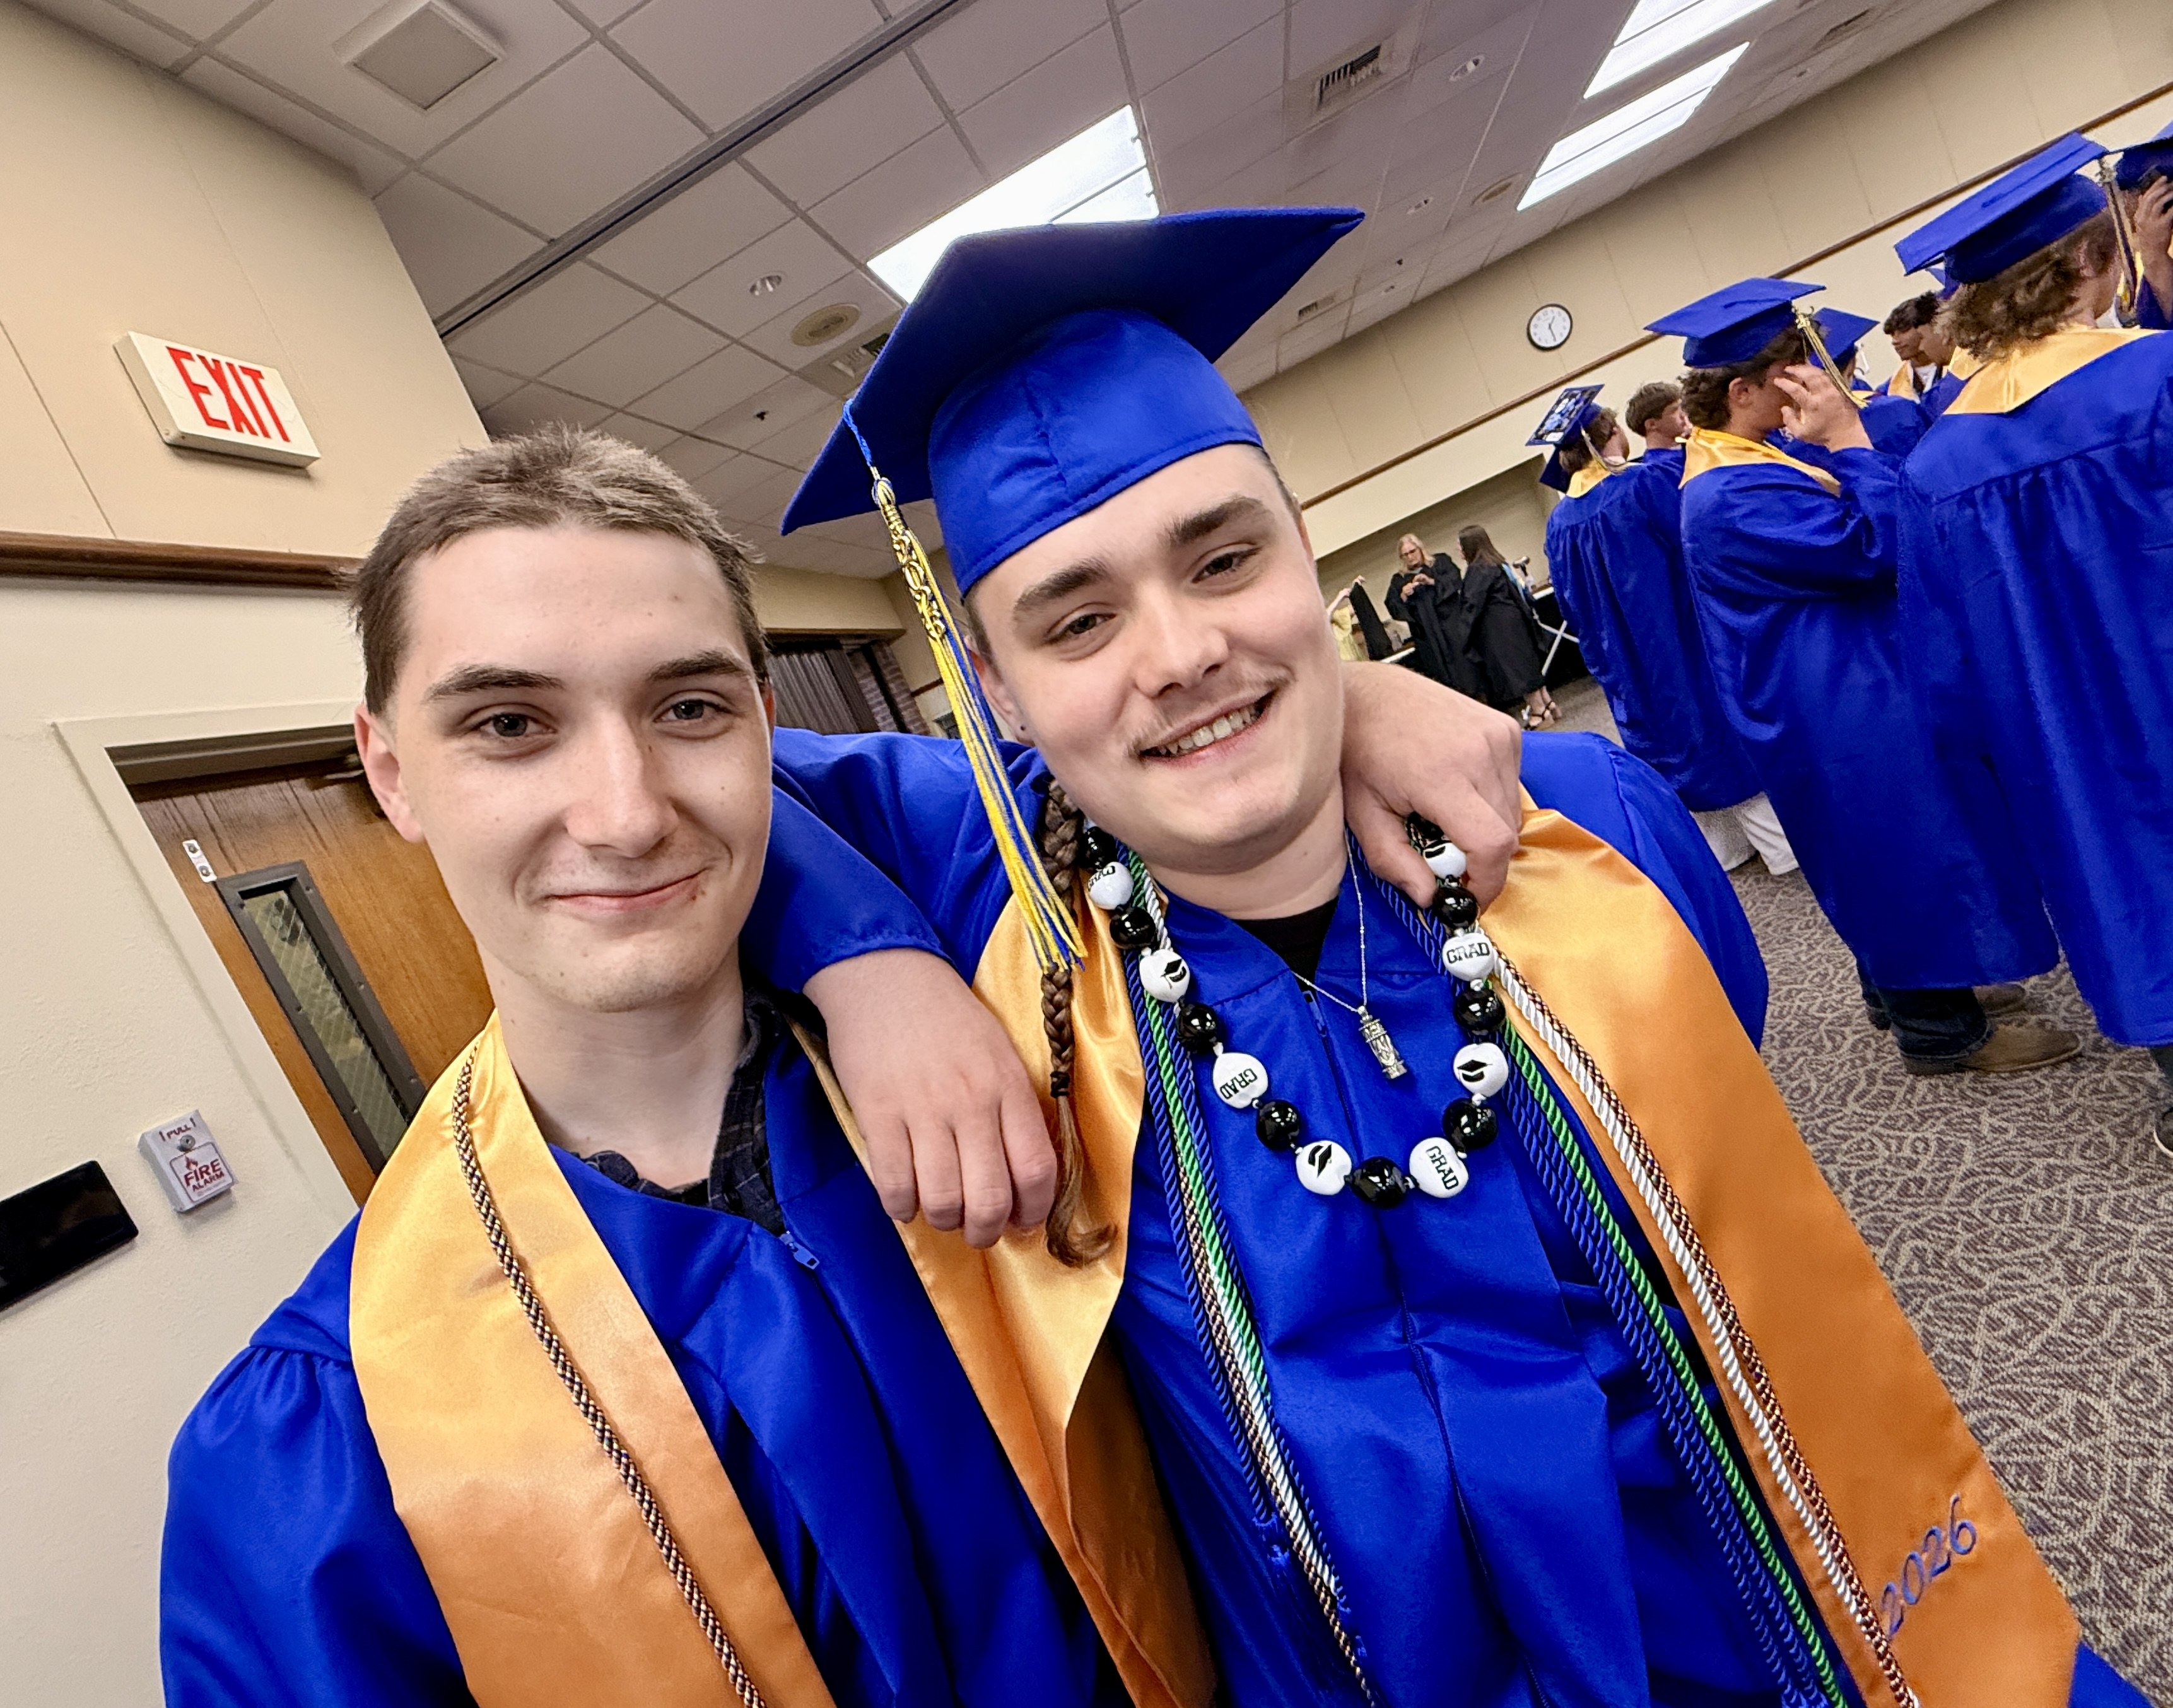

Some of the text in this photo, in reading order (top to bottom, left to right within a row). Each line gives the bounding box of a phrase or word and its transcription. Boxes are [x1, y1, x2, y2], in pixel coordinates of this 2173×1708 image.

[165, 346, 291, 443] EXIT
[1446, 942, 1490, 964] GRAD
[1220, 1068, 1258, 1099] GRAD
[167, 1124, 192, 1139] PULL
[184, 1159, 221, 1187] FIRE
[192, 1171, 225, 1192] ALARM
[1426, 1145, 1459, 1190] GRAD
[1880, 1492, 1977, 1639] 2026
